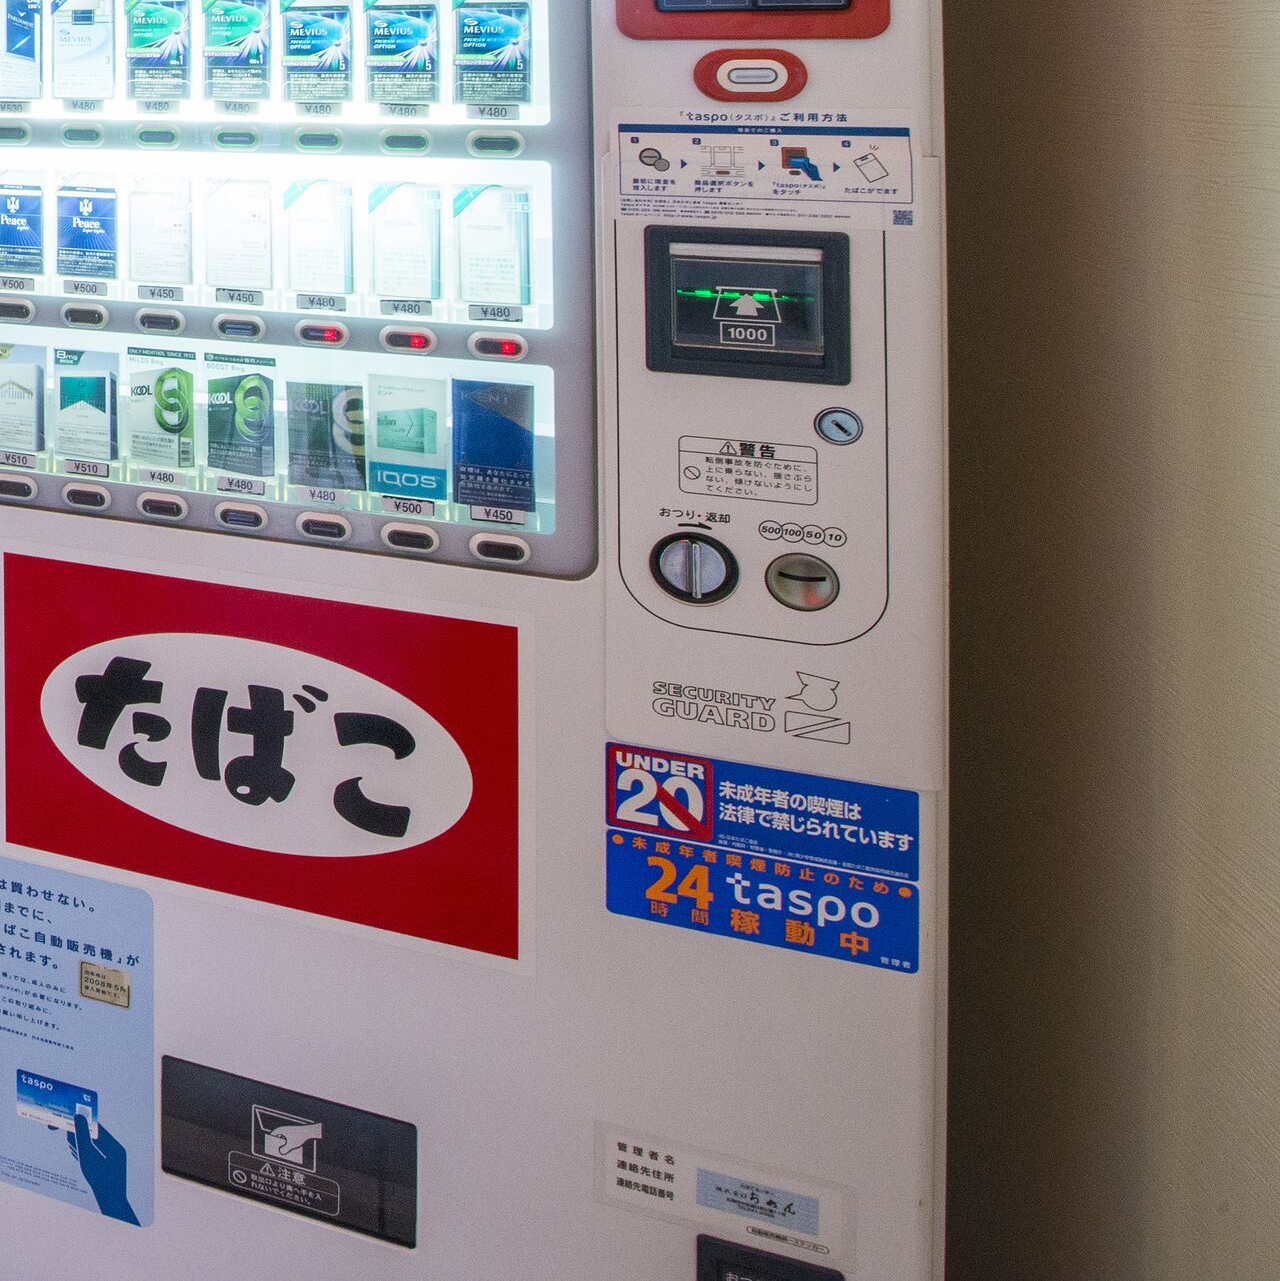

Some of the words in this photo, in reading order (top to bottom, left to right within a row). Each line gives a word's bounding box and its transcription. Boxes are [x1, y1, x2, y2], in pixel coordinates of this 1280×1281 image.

[0, 213, 28, 228] Peace
[727, 326, 768, 342] 1000
[129, 383, 153, 398] KOOL
[739, 442, 776, 459] 警告
[376, 469, 438, 489] IQOS
[658, 507, 731, 524] おつり・返却
[761, 525, 781, 536] 500
[783, 528, 802, 538] 100
[805, 530, 822, 540] 50
[827, 533, 843, 542] 10
[651, 680, 777, 712] SECURITY
[651, 697, 776, 733] GUARD
[74, 655, 418, 839] たばこ
[615, 751, 705, 781] UNDER
[615, 768, 705, 832] 20
[718, 781, 863, 822] 未成年者の喫煙は
[718, 802, 915, 853] 法律で禁じられています
[644, 855, 715, 911] 24
[725, 872, 881, 929] taspo
[19, 1073, 54, 1092] taspo
[616, 1140, 676, 1167] 管理者名
[278, 1166, 307, 1186] 注意
[615, 1158, 676, 1185] 連絡先住所
